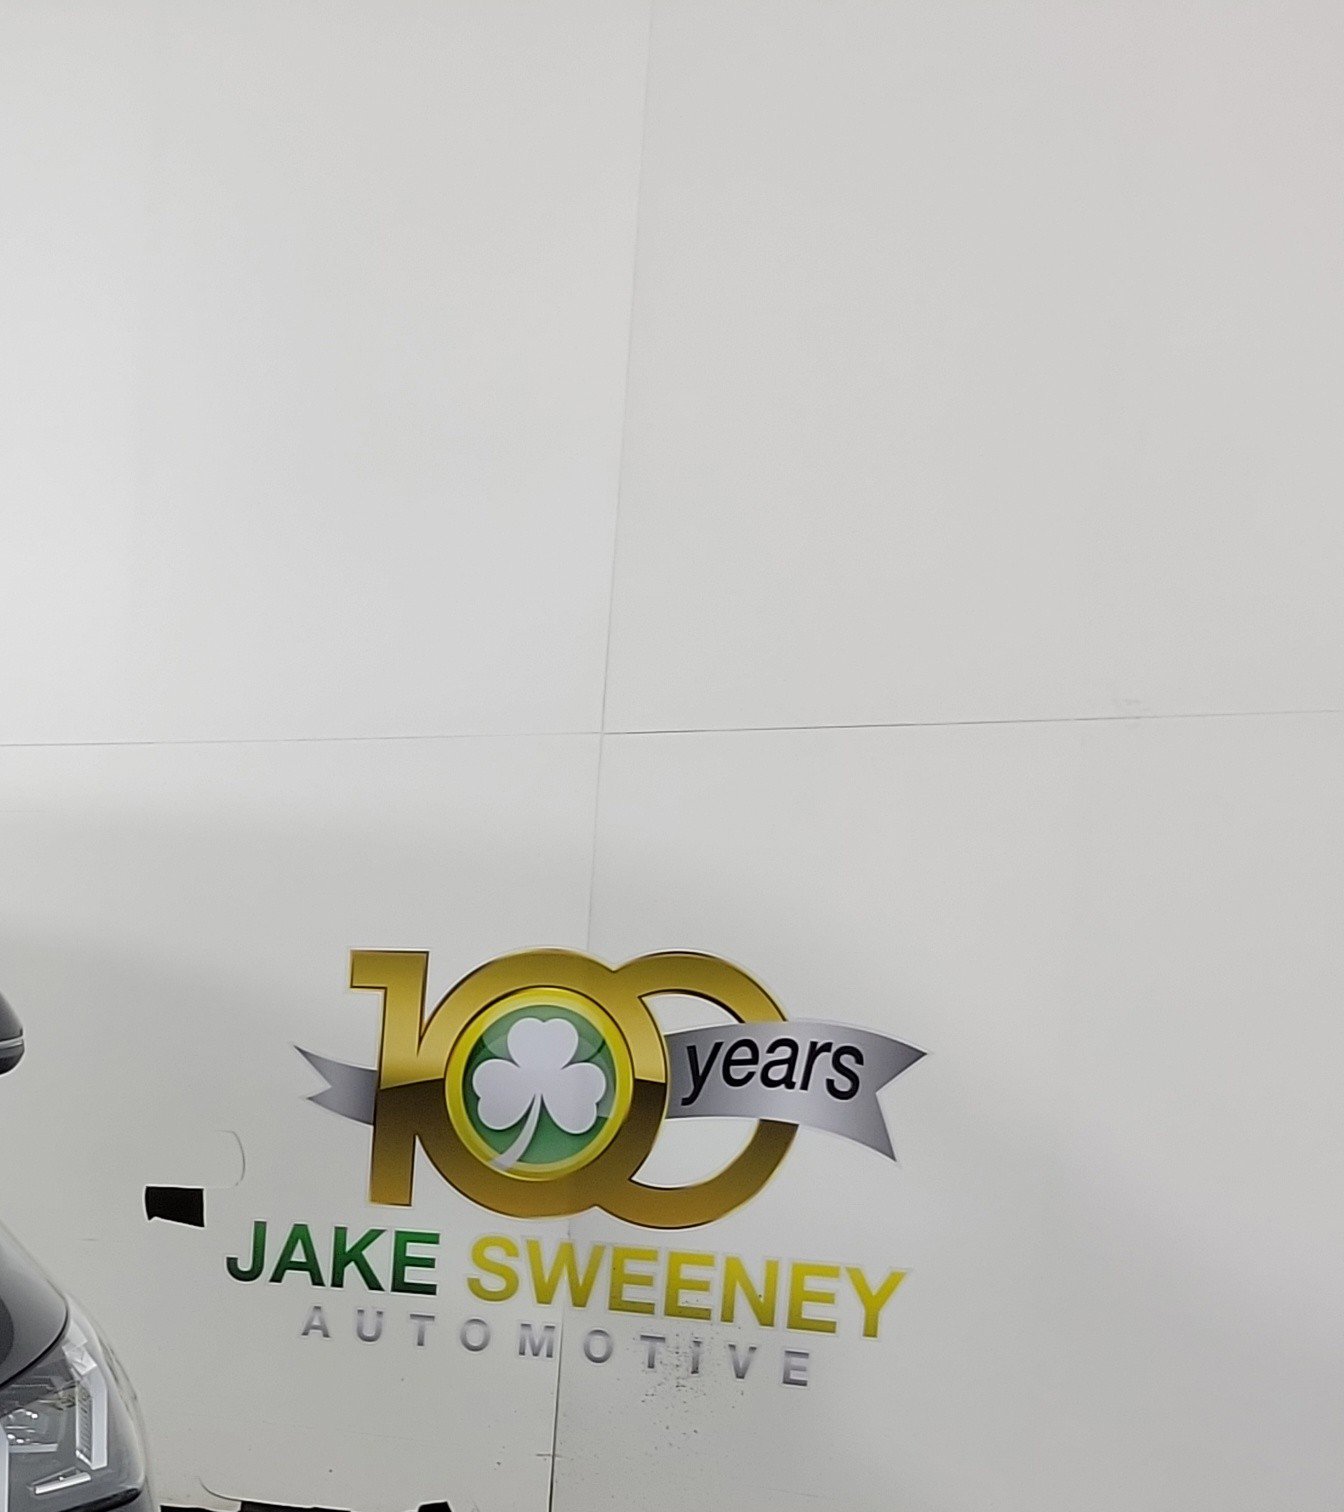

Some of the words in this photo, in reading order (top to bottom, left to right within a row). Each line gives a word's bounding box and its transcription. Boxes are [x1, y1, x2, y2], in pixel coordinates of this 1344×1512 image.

[349, 948, 799, 1230] 100
[680, 1036, 865, 1106] years
[226, 1220, 440, 1296] JAKE
[466, 1235, 906, 1339] SWEENEY
[302, 1305, 810, 1387] AUTOMOTIVE
